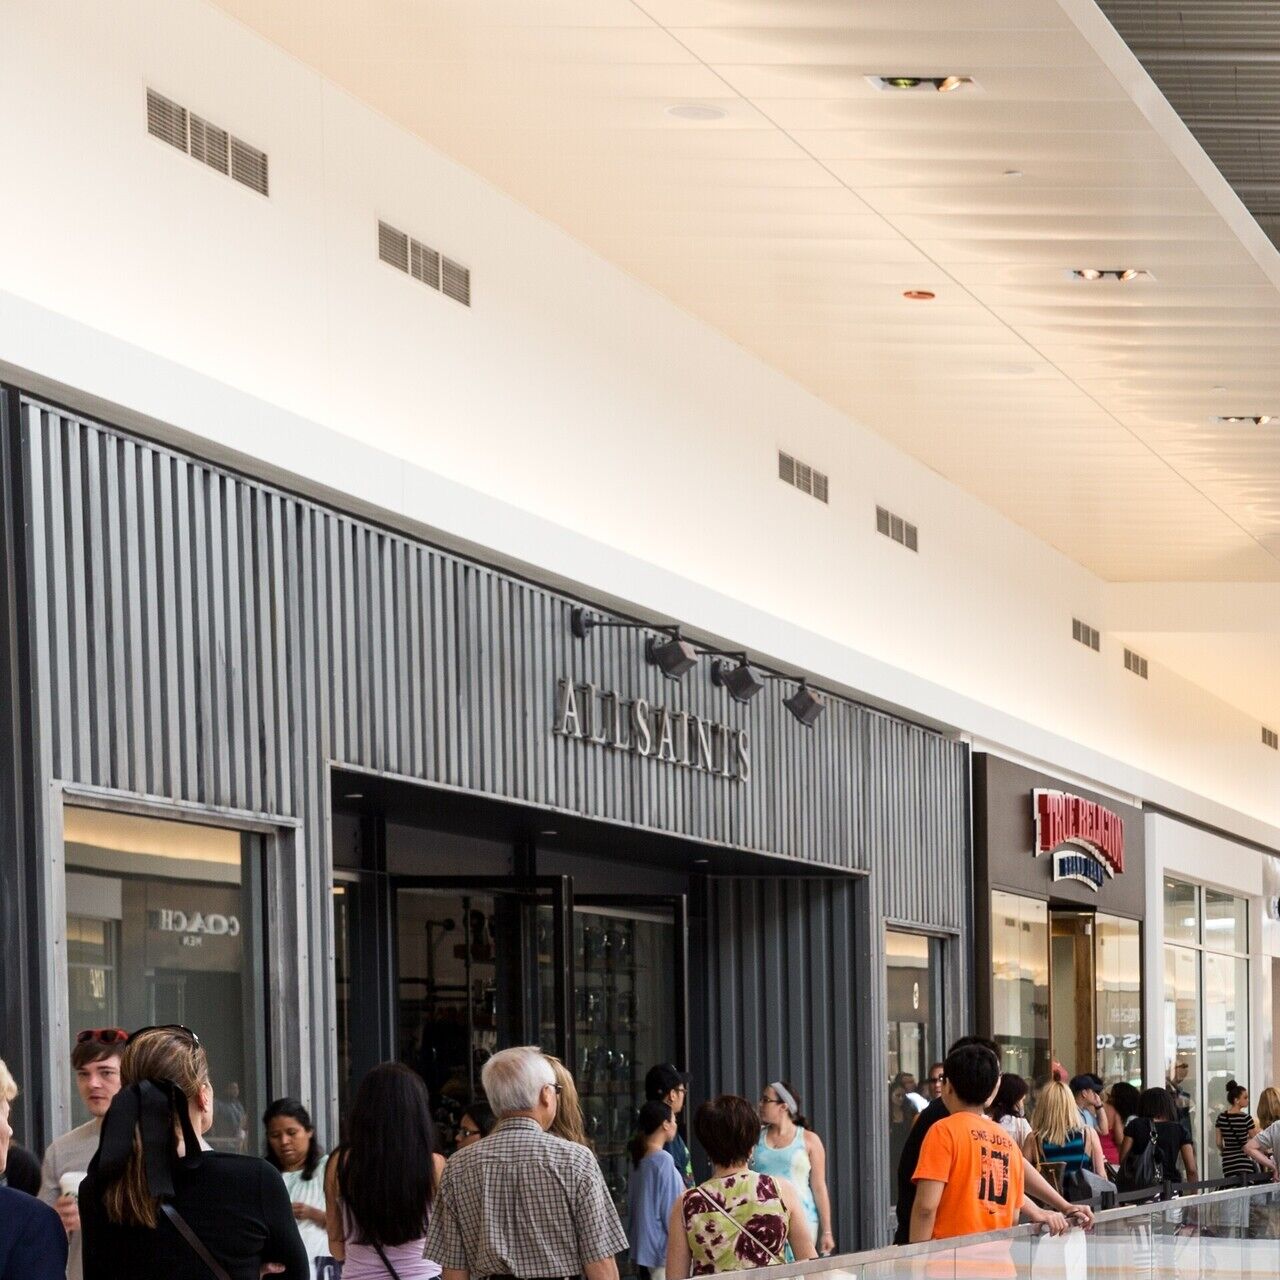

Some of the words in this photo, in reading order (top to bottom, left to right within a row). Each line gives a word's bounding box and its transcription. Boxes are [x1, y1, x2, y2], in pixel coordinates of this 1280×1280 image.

[556, 676, 749, 782] ALLSAINTS
[1040, 794, 1075, 850] TRUE
[1078, 797, 1124, 873] RELIGION
